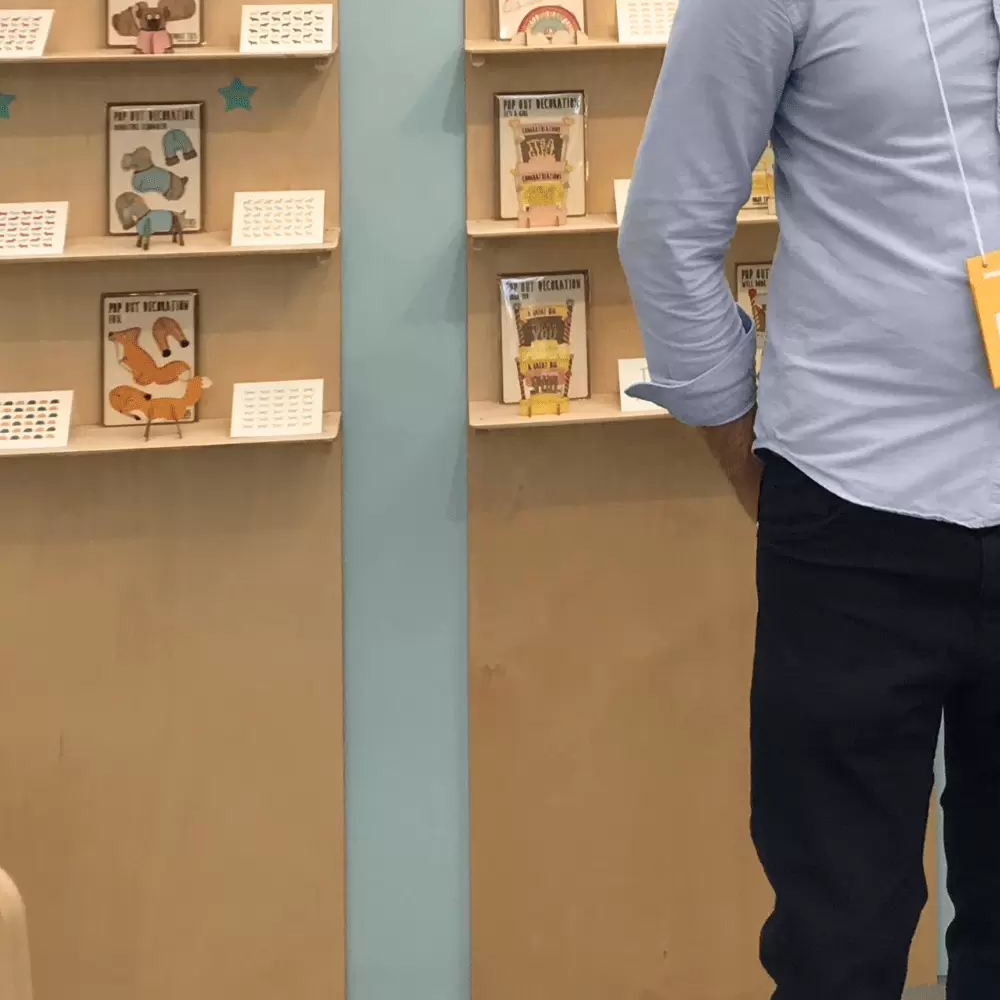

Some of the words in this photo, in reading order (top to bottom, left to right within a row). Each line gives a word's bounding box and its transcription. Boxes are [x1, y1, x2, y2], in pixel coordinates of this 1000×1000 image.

[503, 99, 516, 110] POP
[519, 98, 532, 109] OUT
[741, 269, 753, 279] POP
[756, 268, 770, 279] OUT
[520, 281, 534, 292] OUT
[538, 279, 581, 292] DECORATION
